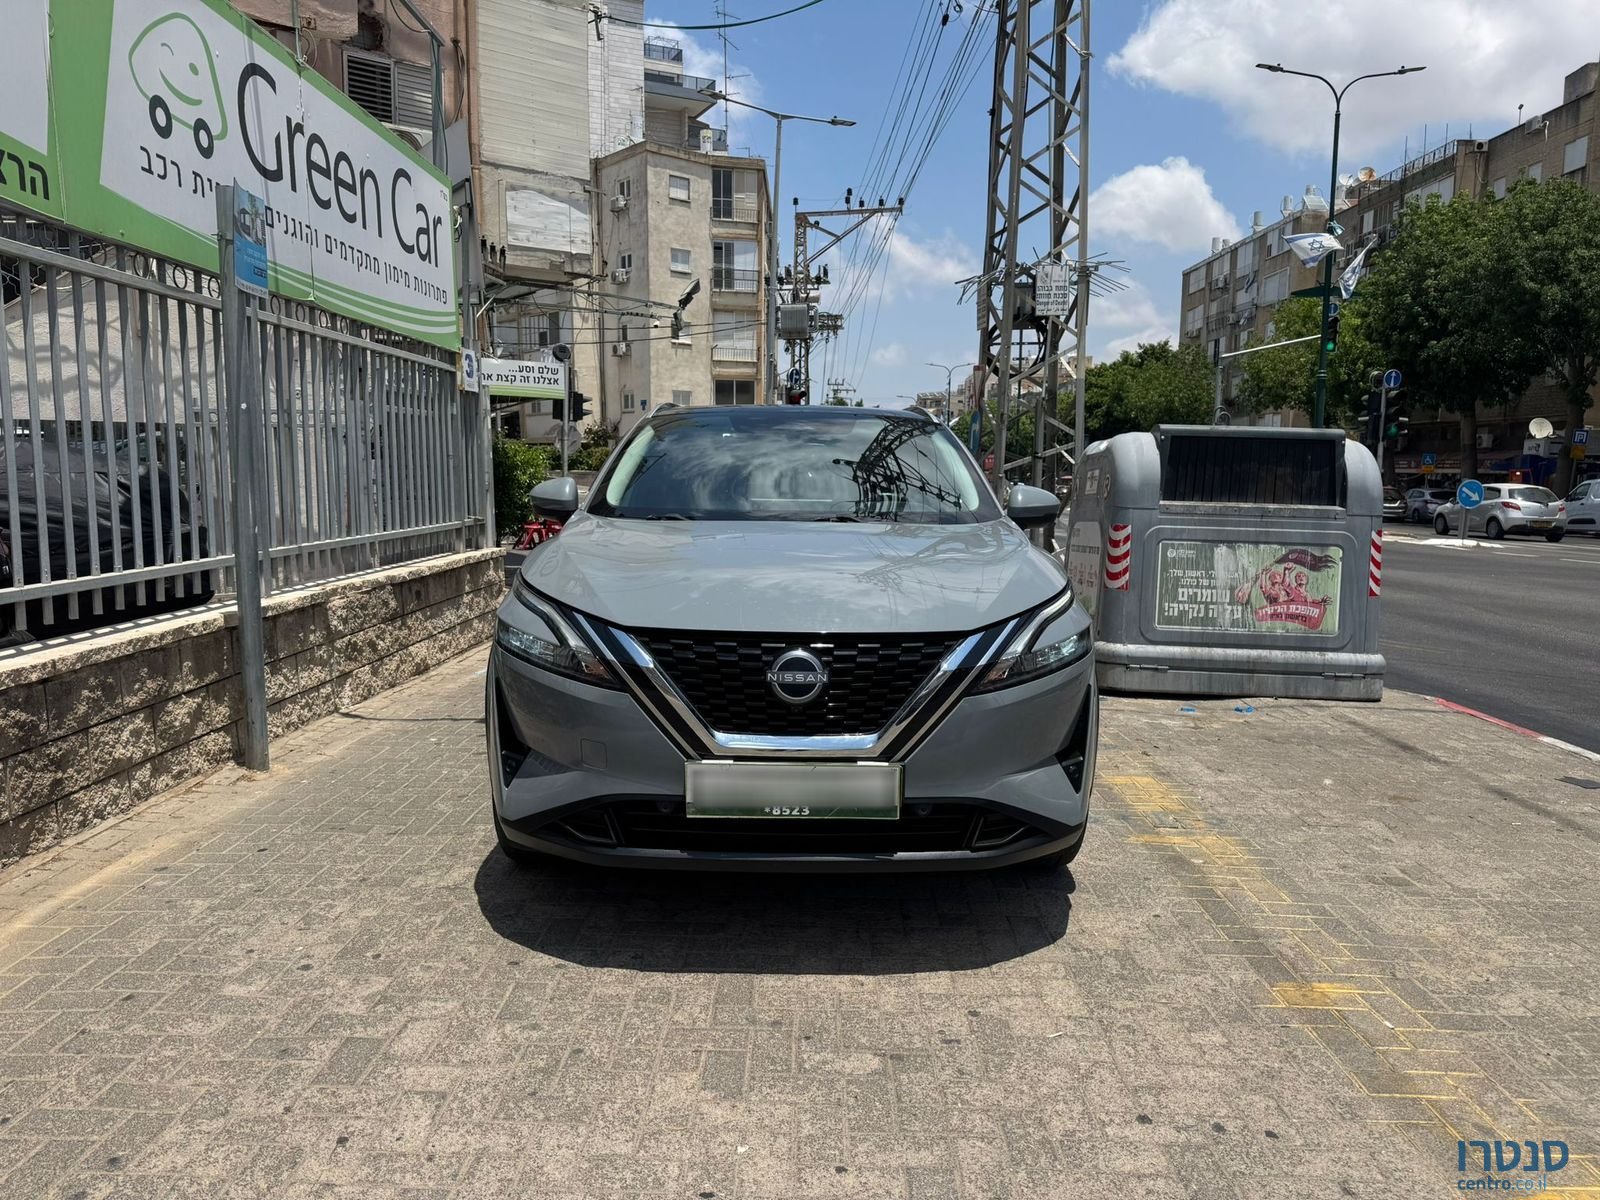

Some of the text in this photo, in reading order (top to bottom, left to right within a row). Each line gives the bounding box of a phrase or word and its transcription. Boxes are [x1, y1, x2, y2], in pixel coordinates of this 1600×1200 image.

[139, 144, 182, 188] רכב
[237, 62, 443, 268] Green Car
[264, 205, 448, 305] פתרונות מימון מתקדמים והוגנים
[464, 353, 474, 379] 3
[508, 364, 559, 376] שלם וסע...
[496, 373, 517, 385] קצת
[519, 375, 531, 384] זה
[533, 374, 560, 386] אצלנו
[1178, 587, 1231, 603] שומרים
[1164, 602, 1243, 620] עלה נקייה!
[767, 672, 828, 683] NISSAN
